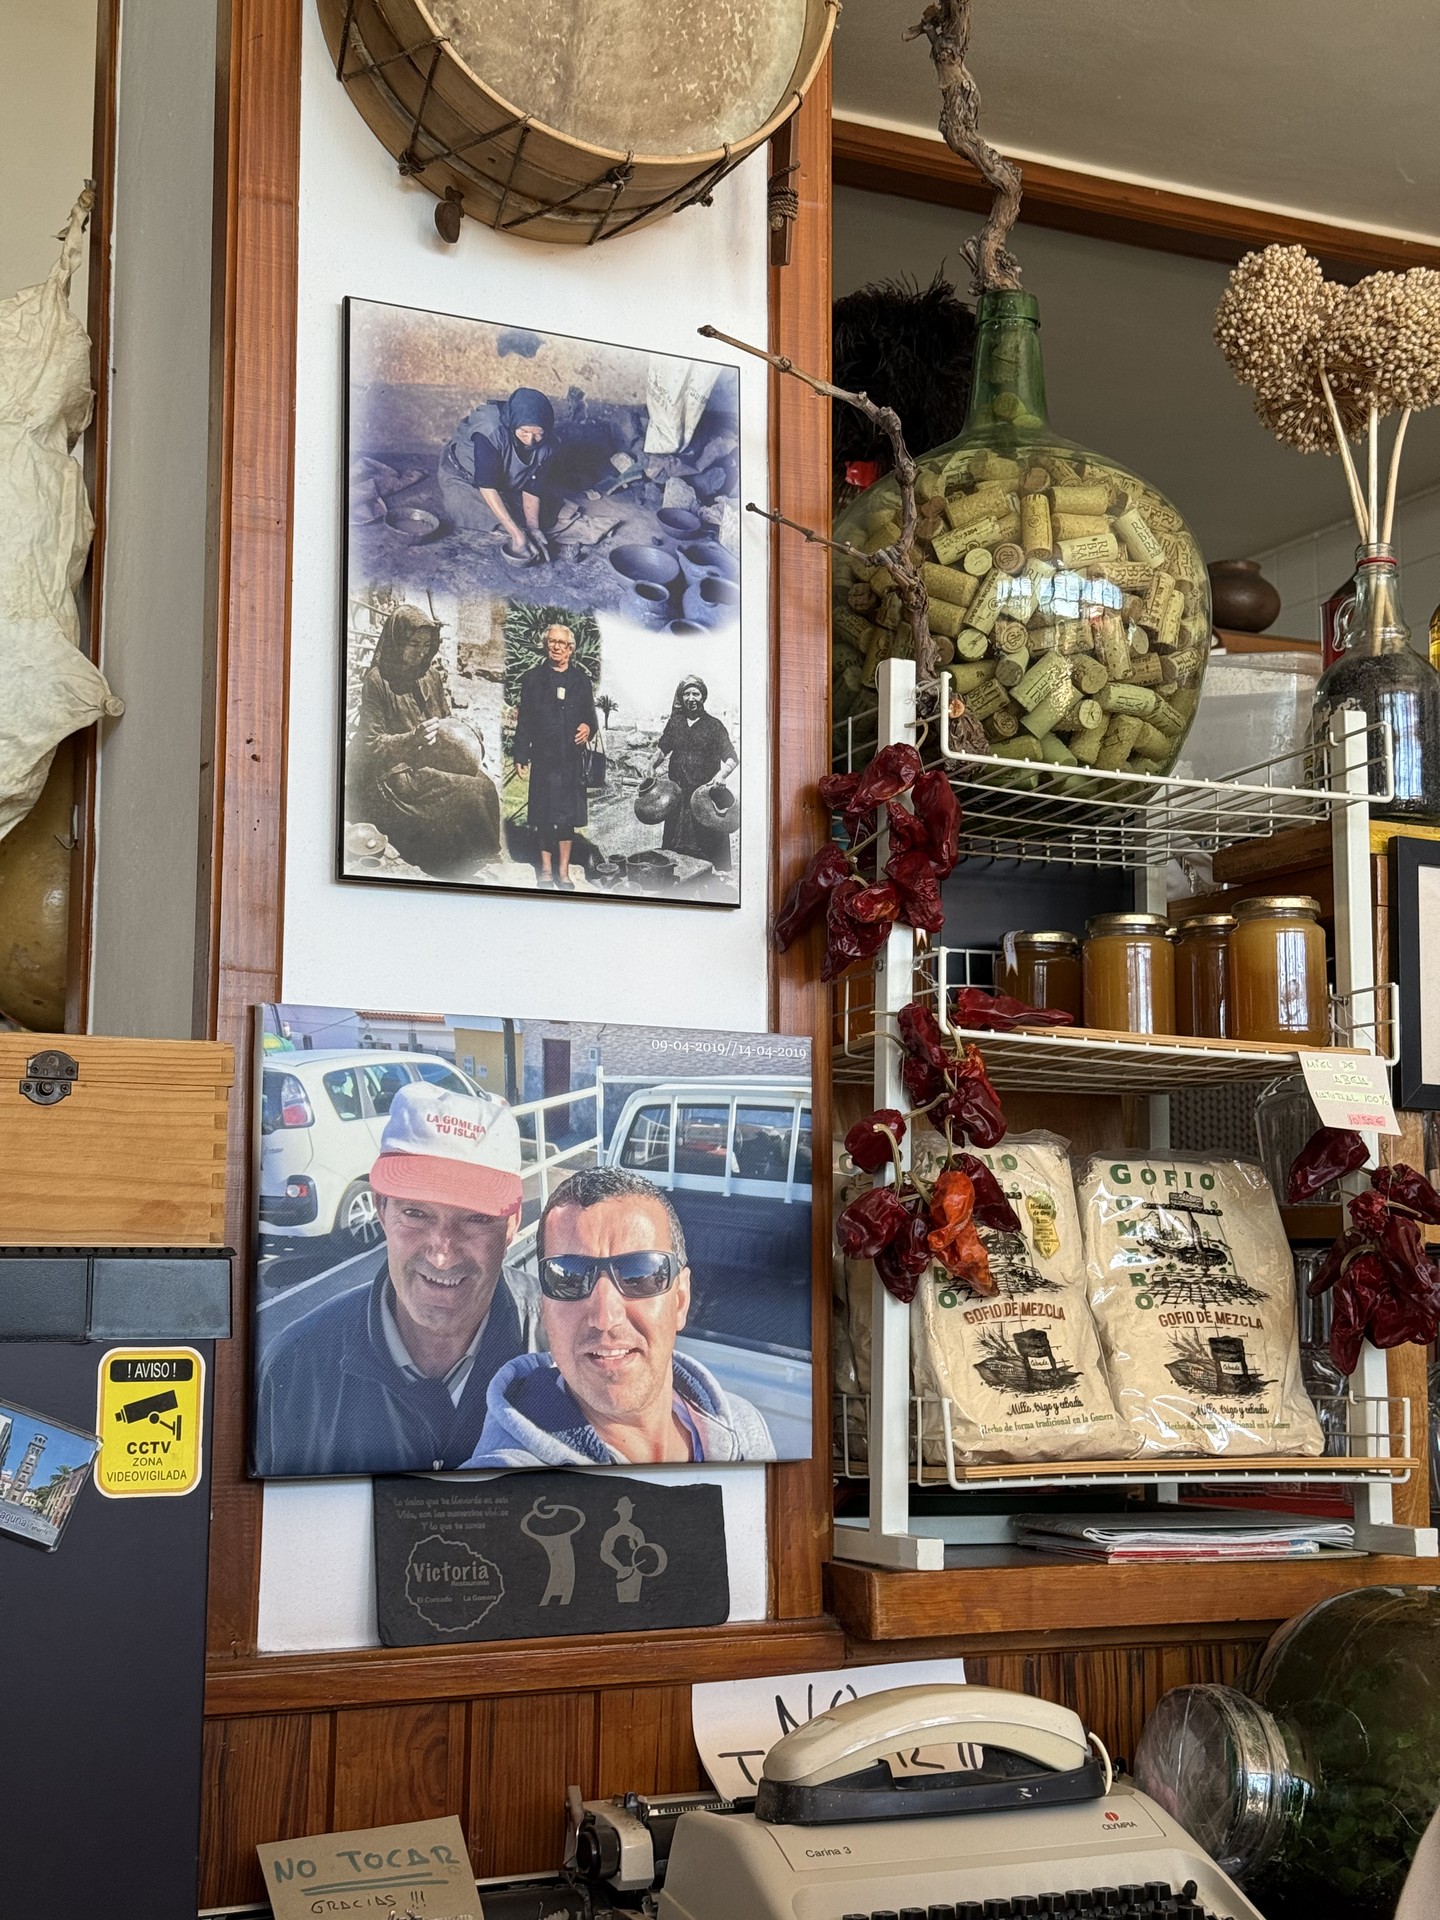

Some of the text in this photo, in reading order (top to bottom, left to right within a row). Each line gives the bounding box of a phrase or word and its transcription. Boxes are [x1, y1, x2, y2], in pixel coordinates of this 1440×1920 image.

[651, 1039, 807, 1060] 09-04-2019//14-04-2019
[426, 1114, 486, 1134] LA GOMERA
[436, 1124, 476, 1140] TU ISLA
[1110, 1164, 1215, 1190] GOFIO
[963, 1302, 1066, 1325] GOFIO DE MEZCLA
[1158, 1311, 1265, 1330] GOFIO DE MEZCLA
[134, 1362, 170, 1378] AVISO
[1004, 1422, 1013, 1432] de
[1014, 1421, 1035, 1431] forma
[1036, 1416, 1071, 1429] tradicional
[1073, 1417, 1081, 1425] en
[1082, 1414, 1089, 1423] la
[1090, 1413, 1114, 1422] Gomera
[127, 1441, 171, 1455] CCTV
[132, 1457, 163, 1467] ZONA
[107, 1469, 187, 1482] VIDEOVIGILADA
[0, 1511, 27, 1527] aguna
[413, 1561, 489, 1583] Victoria
[463, 1594, 471, 1602] La
[472, 1594, 497, 1602] Gomera
[1102, 1821, 1138, 1830] OLYMPIA
[805, 1846, 852, 1858] Carina 3
[273, 1845, 460, 1884] NO TOCAR
